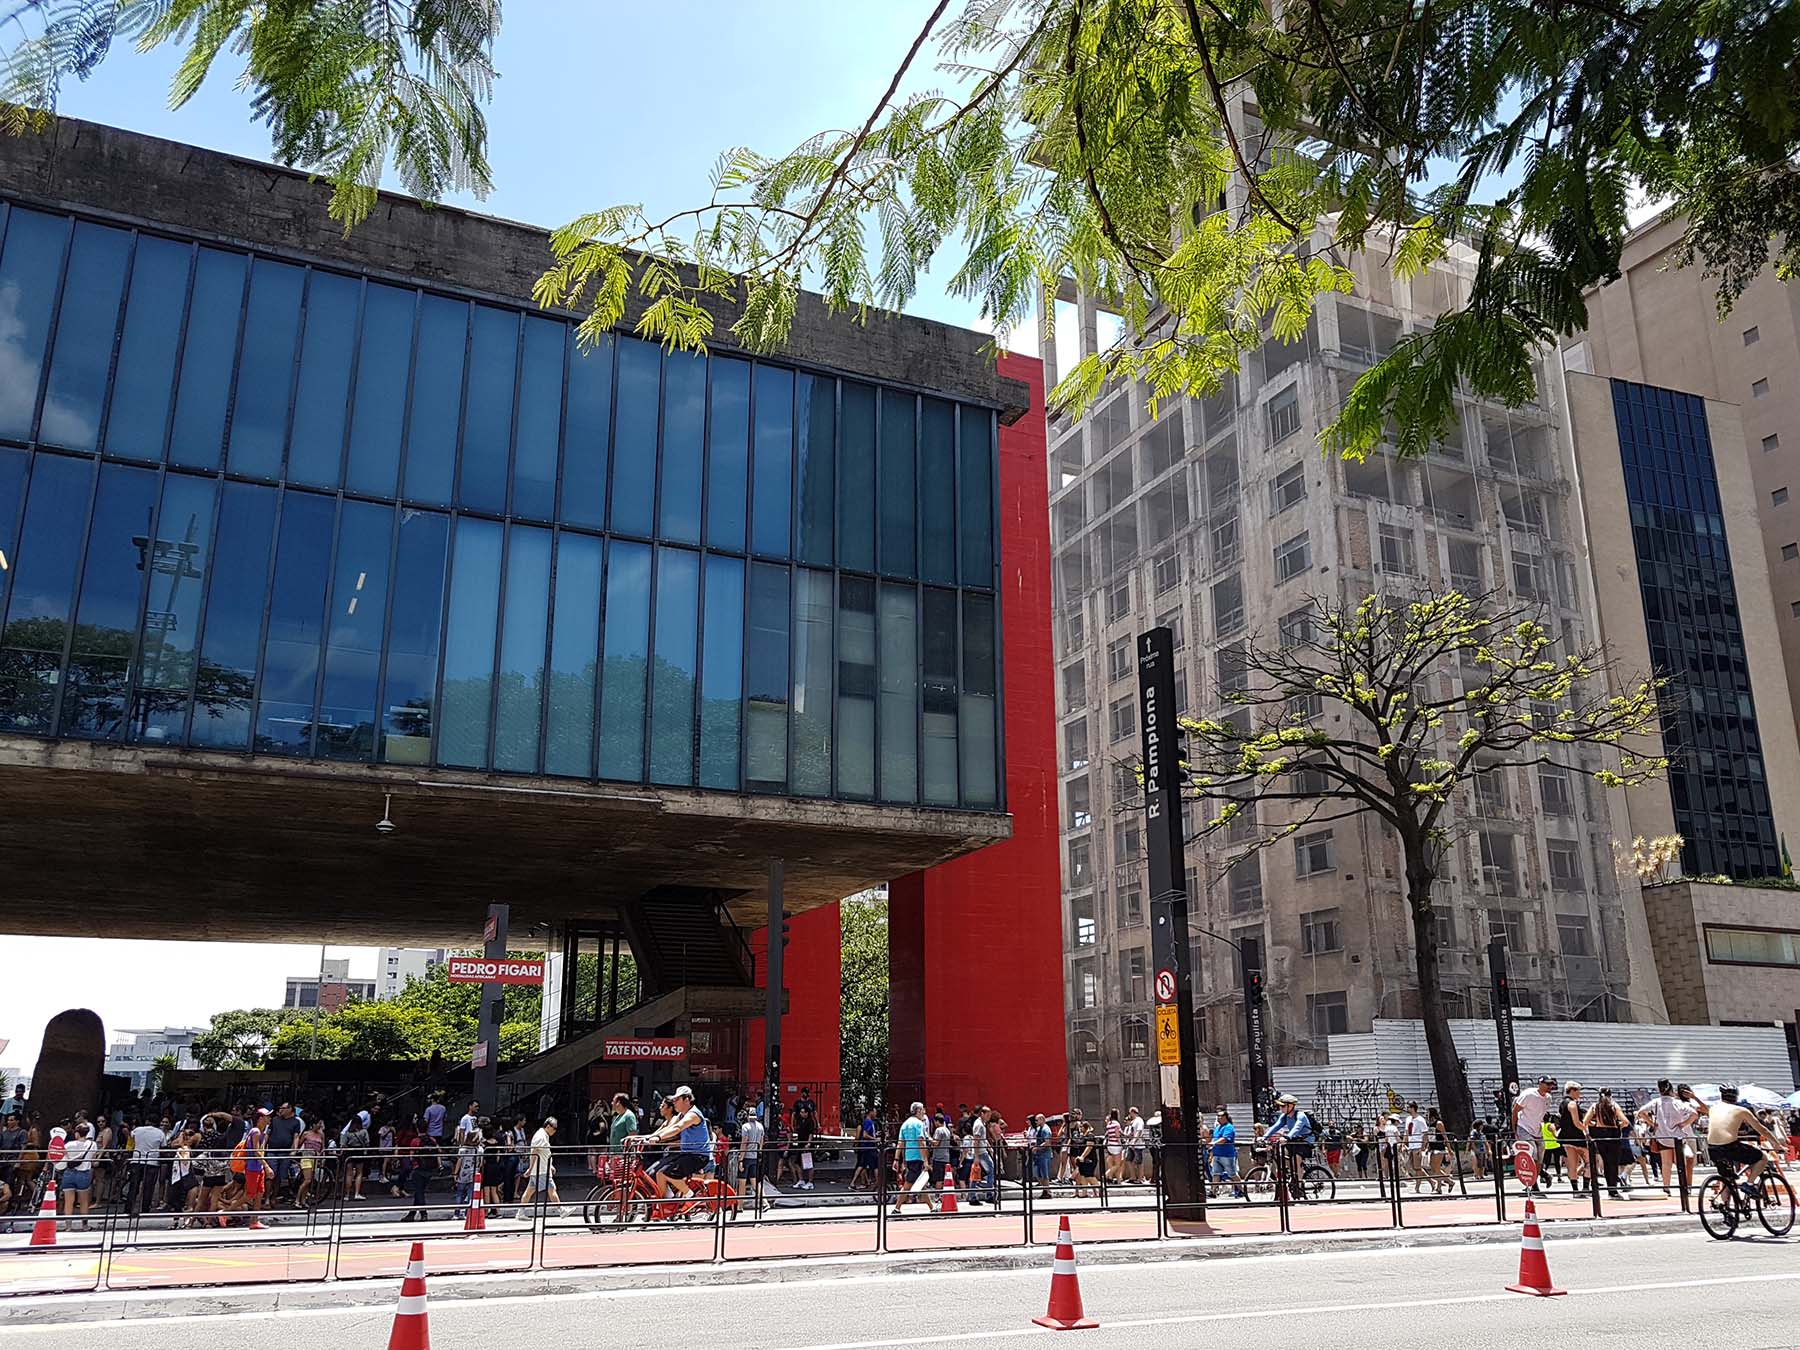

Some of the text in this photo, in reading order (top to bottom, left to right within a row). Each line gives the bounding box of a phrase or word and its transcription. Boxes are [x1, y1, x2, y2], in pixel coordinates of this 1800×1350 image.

[1146, 686, 1160, 819] R. Pamplona
[451, 962, 542, 977] PEDRO FIGARI
[1252, 1008, 1261, 1050] Paulista
[1501, 1009, 1511, 1047] Paulista
[605, 1045, 684, 1056] TATE NO MASP
